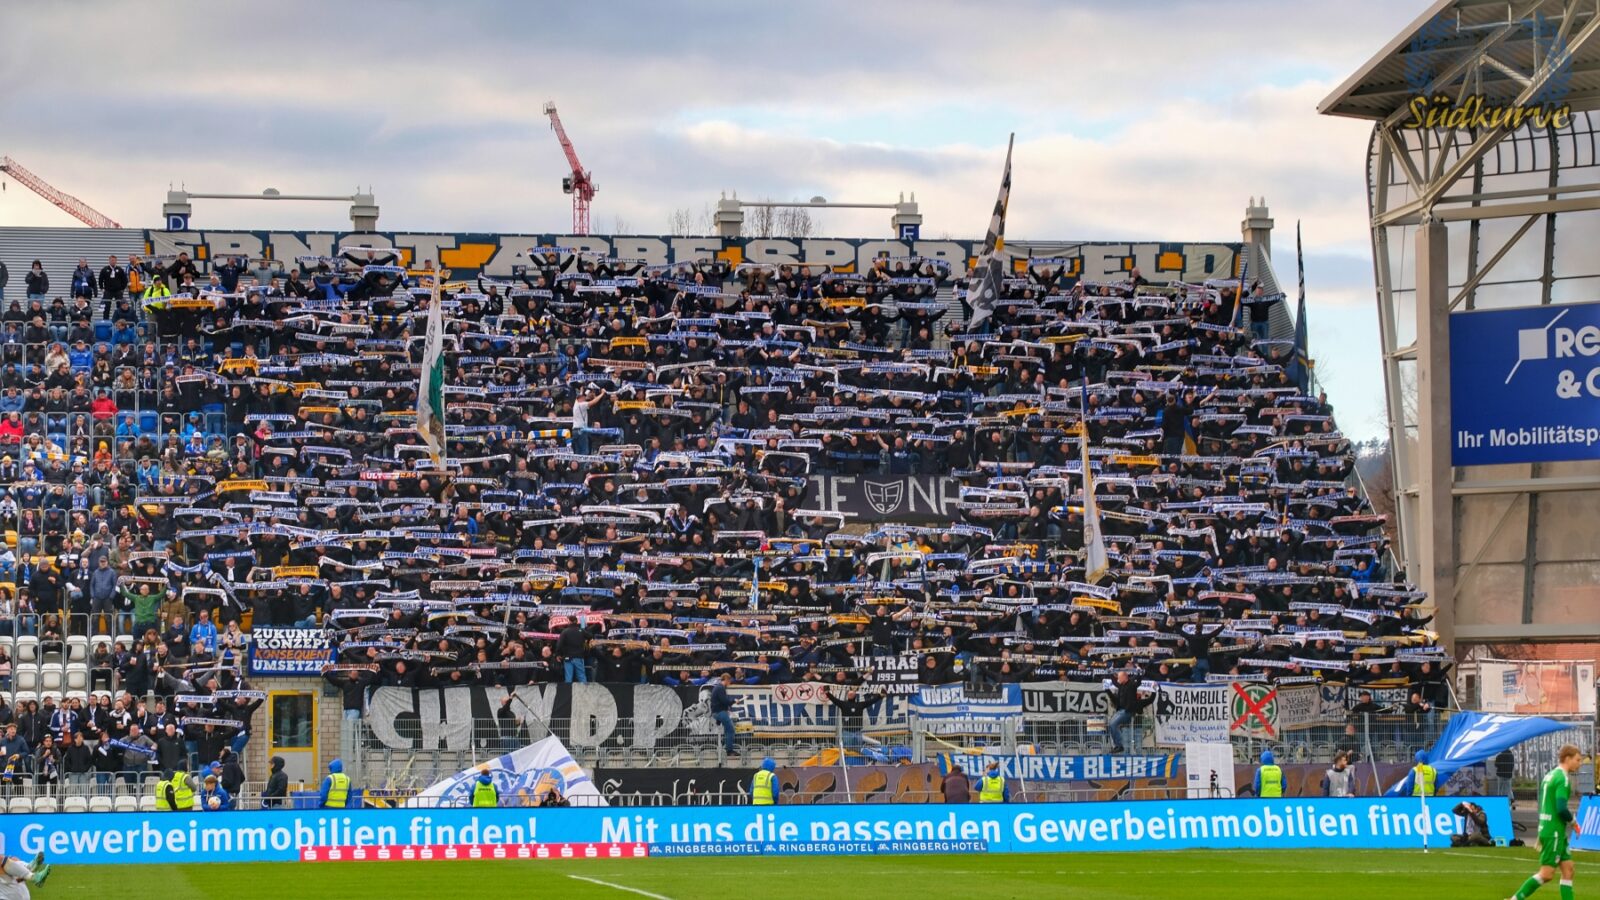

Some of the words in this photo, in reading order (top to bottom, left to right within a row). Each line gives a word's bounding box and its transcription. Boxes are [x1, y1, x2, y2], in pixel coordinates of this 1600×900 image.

[170, 215, 184, 231] D
[1458, 431, 1484, 448] Ihr
[1490, 426, 1600, 446] Mobilitätsp
[257, 638, 329, 649] KONZEPT
[255, 649, 332, 660] KONSEQUENT
[851, 656, 918, 671] ULTRAS
[877, 673, 896, 681] 1993
[1175, 690, 1228, 704] BAMBULE
[1348, 687, 1409, 700] REUGEES
[1024, 690, 1108, 713] ULTRAS
[1175, 706, 1228, 720] RANDALE
[954, 755, 1074, 779] SÜDKURVE
[1083, 756, 1164, 779] BLEIBT
[601, 816, 659, 844] Mit
[671, 821, 733, 842] uns
[745, 813, 798, 842] die
[811, 812, 1001, 843] passenden
[1013, 805, 1359, 843] Gewerbeimmobilien
[20, 816, 397, 855] Gewerbeimmobilien
[409, 815, 537, 846] finden!
[665, 844, 723, 854] RINGBERG
[724, 843, 760, 853] HOTEL
[779, 843, 837, 853] RINGBERG
[838, 842, 874, 852] HOTEL
[892, 842, 949, 852] RINGBERG
[951, 841, 987, 851] HOTEL
